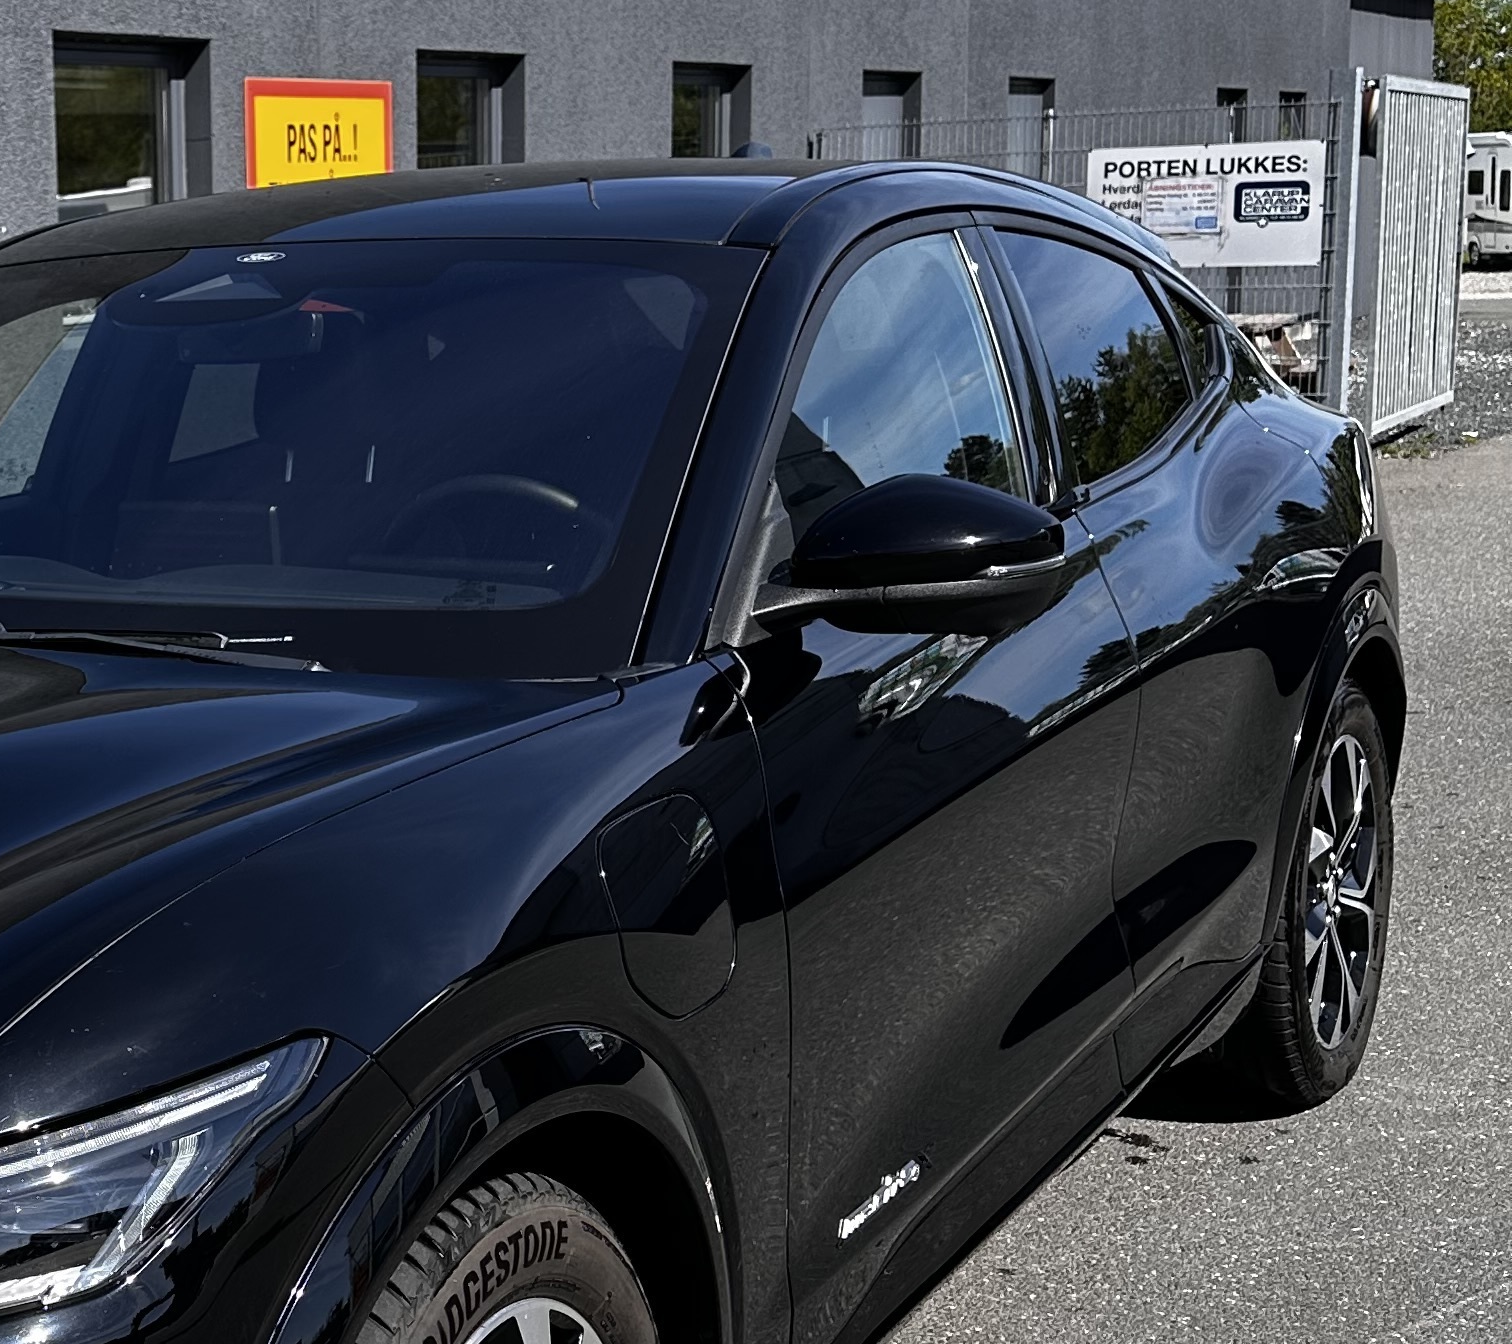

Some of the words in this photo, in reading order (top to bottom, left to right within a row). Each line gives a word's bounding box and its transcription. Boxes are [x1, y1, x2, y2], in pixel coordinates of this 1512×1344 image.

[287, 123, 318, 164] PAS
[1103, 158, 1198, 179] PORTEN
[1205, 155, 1309, 176] LUKKES:
[1244, 189, 1300, 198] KLARUP
[1244, 197, 1310, 206] CARAVAN
[1243, 205, 1298, 214] CENTER
